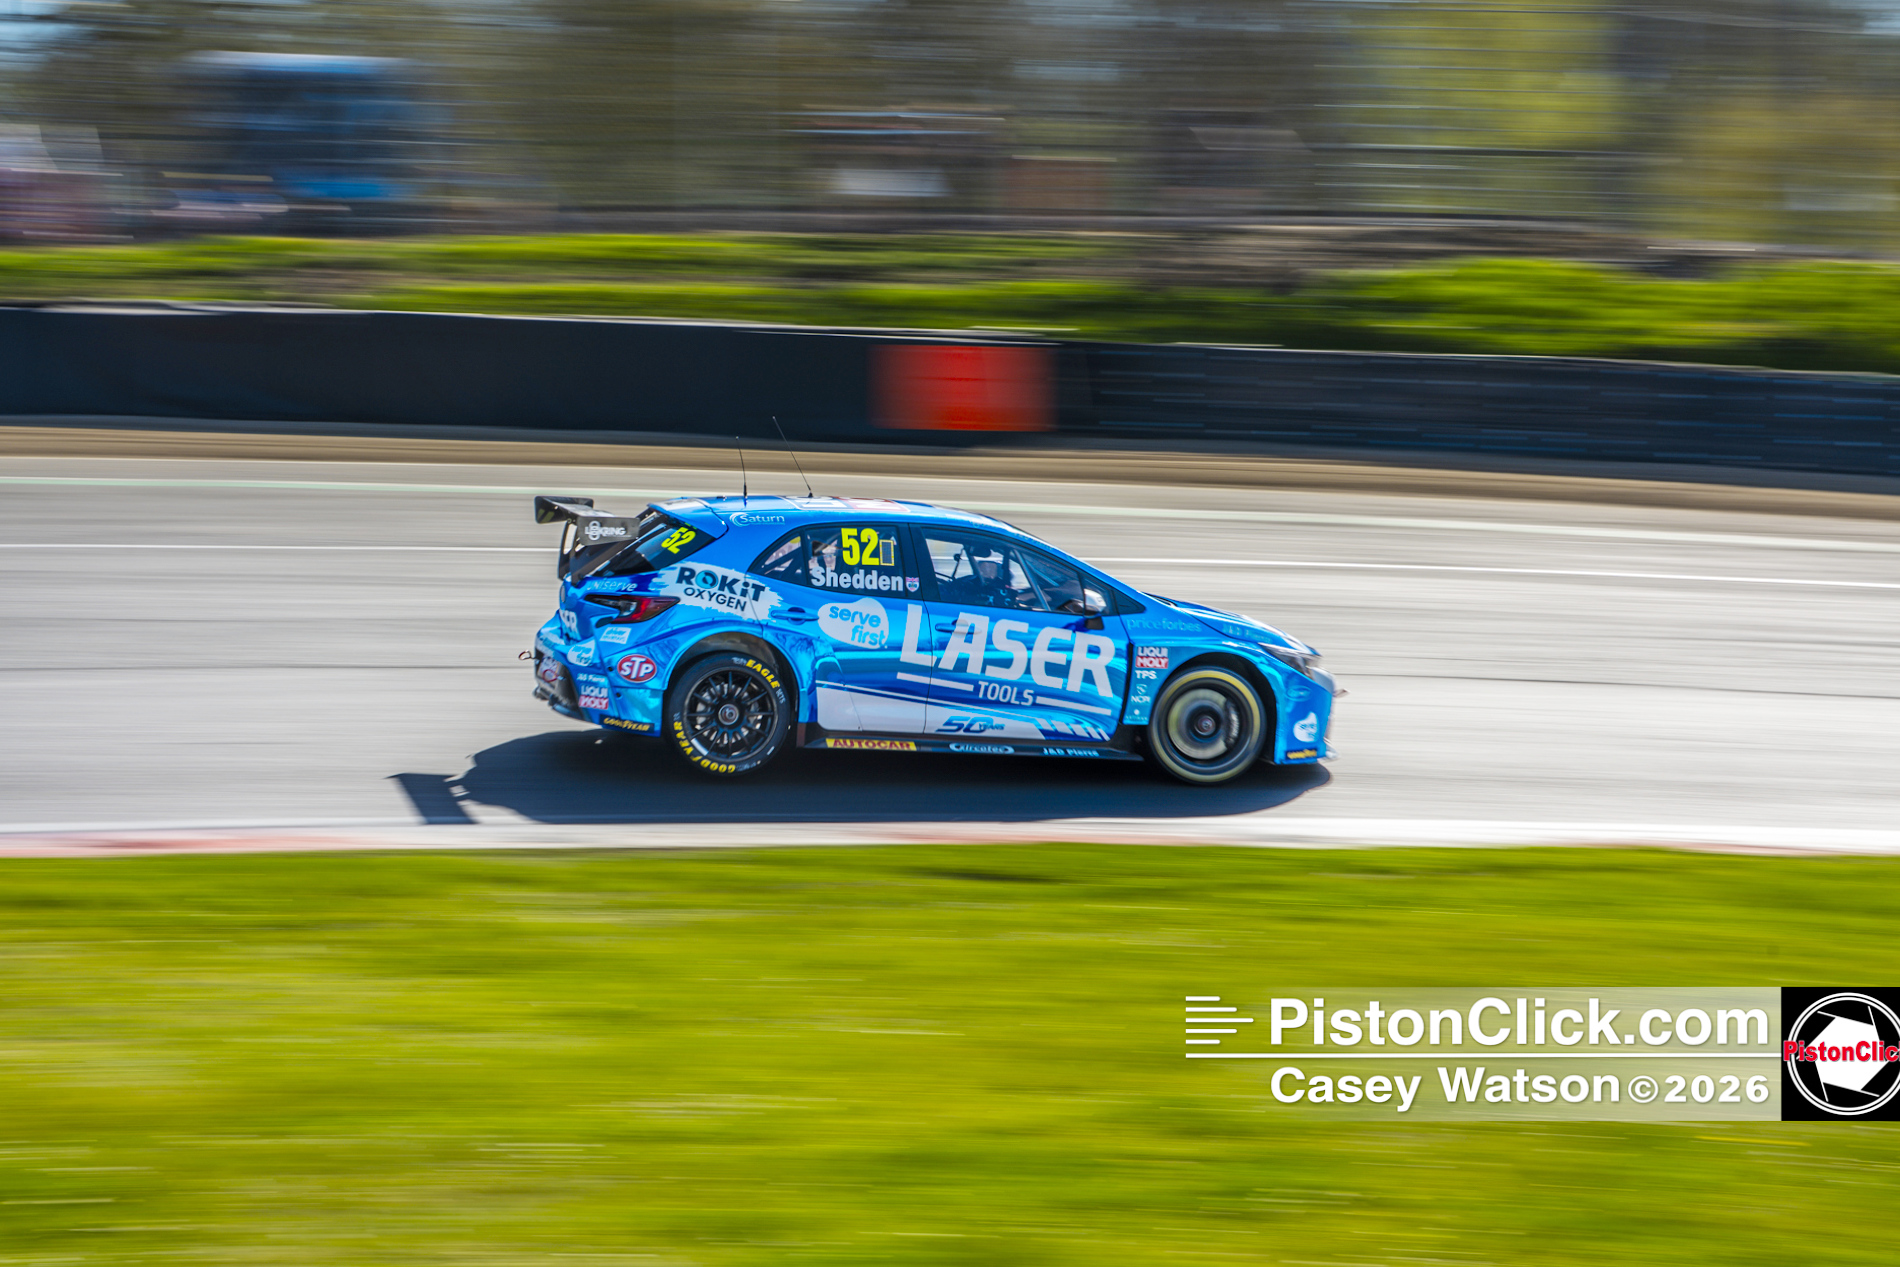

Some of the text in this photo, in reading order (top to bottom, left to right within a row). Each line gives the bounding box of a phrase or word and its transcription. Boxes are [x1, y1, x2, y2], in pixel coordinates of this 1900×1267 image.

[738, 514, 785, 523] Saturn
[661, 527, 696, 554] 52
[841, 527, 880, 566] 52
[811, 566, 904, 592] Shedden
[684, 587, 747, 612] OXYGEN
[829, 605, 881, 628] serve
[900, 603, 1116, 698] LASER
[1136, 656, 1169, 668] MOLY
[1137, 646, 1169, 658] LIQUI
[619, 657, 654, 680] STP
[746, 659, 781, 689] EAGLE
[1135, 670, 1157, 680] TPS
[580, 696, 609, 709] MOLY
[581, 685, 609, 698] LIQUI
[978, 681, 1034, 706] TOOLS
[935, 715, 994, 733] 50
[833, 739, 911, 750] AUTOCAR
